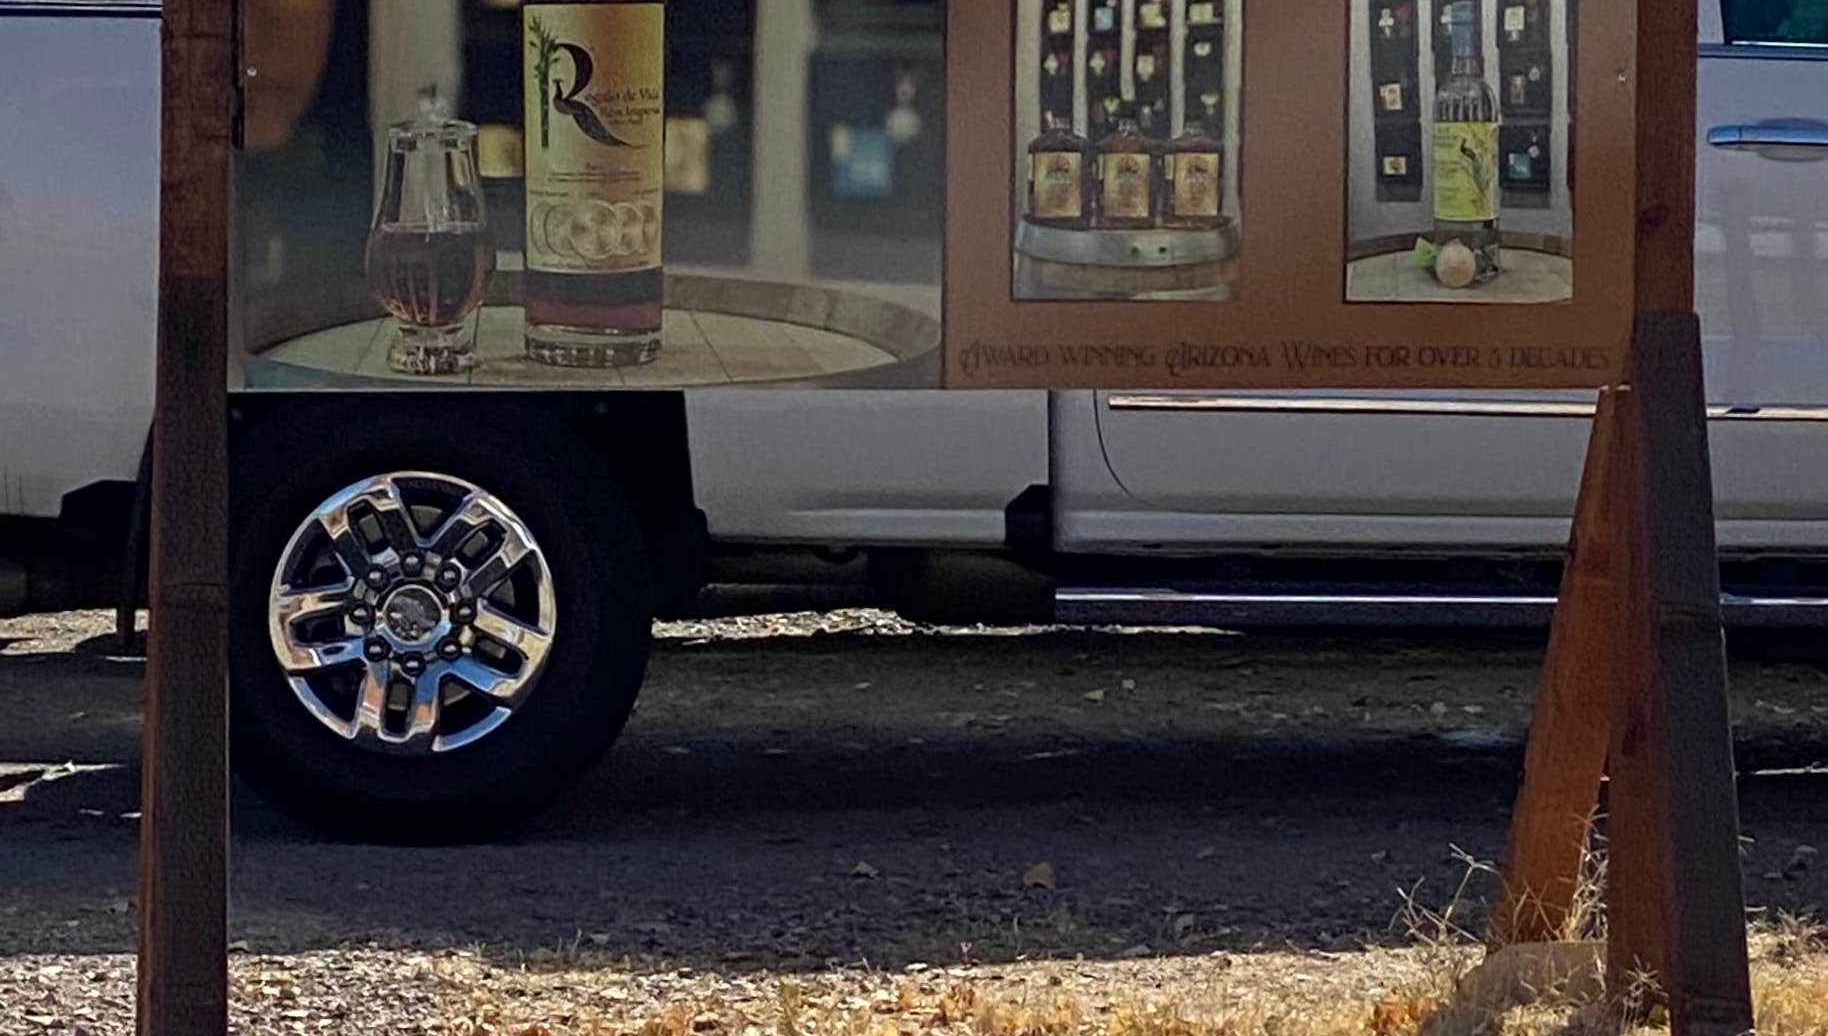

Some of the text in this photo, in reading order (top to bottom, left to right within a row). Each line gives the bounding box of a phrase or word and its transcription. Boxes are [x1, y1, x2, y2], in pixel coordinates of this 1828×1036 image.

[1059, 343, 1156, 366] WINNING
[1366, 345, 1410, 366] FOR
[1418, 345, 1480, 367] OVER
